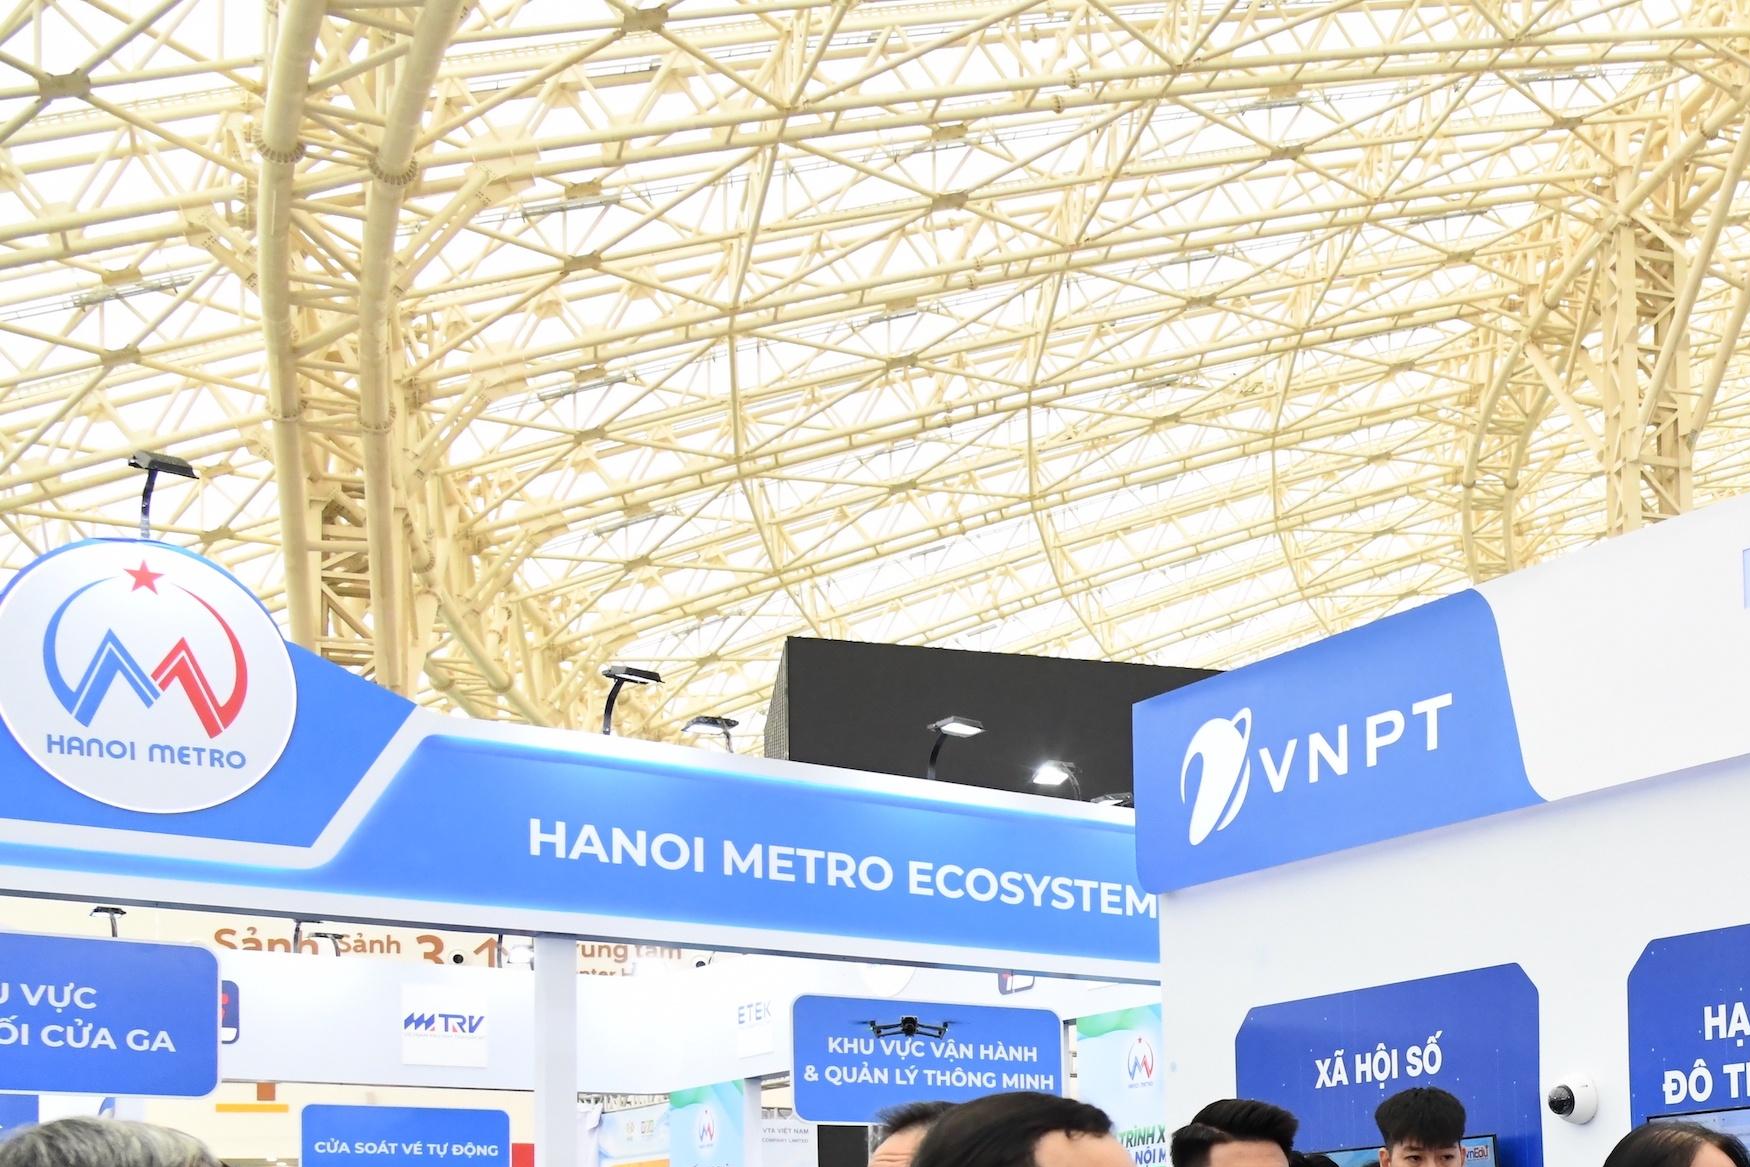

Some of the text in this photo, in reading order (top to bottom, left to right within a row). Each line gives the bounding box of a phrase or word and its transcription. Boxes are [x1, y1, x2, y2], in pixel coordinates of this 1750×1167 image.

[46, 733, 247, 769] HANOI METRO
[1258, 692, 1453, 794] VNPT
[528, 818, 1157, 920] HANOI METRO ECOSYSTEM
[576, 943, 629, 963] ung
[20, 982, 97, 1014] VỰC
[40, 1018, 117, 1050] CỬA
[126, 1029, 177, 1052] GA
[828, 1036, 1038, 1063] KHU VỰC VẬN HÀNH
[803, 1061, 1054, 1090] & QUẢN LÝ THÔNG MINH
[1314, 1030, 1443, 1090] XÃ HỘI SỐ
[1662, 1059, 1714, 1105] ĐÔ
[314, 1138, 499, 1158] CỬA SOÁT VÉ TỰ ĐỘNG
